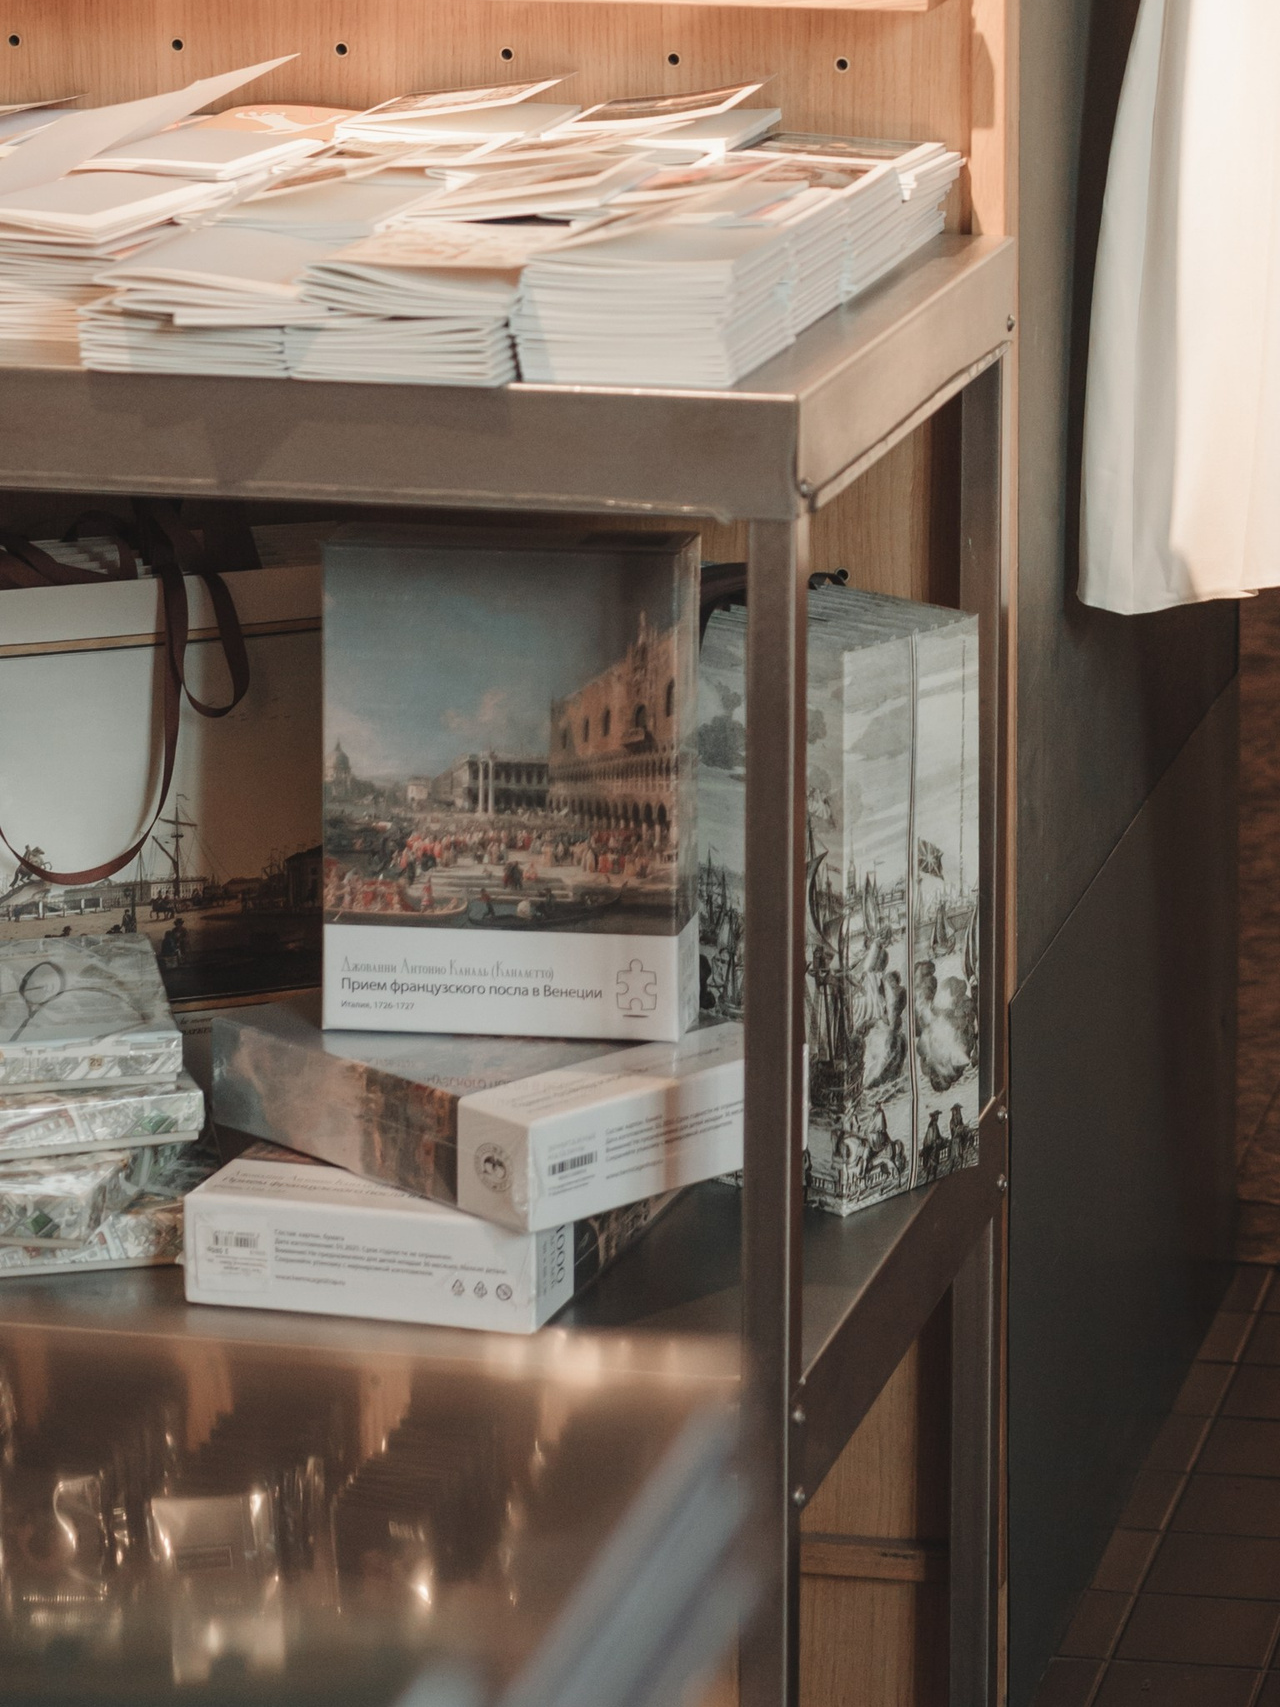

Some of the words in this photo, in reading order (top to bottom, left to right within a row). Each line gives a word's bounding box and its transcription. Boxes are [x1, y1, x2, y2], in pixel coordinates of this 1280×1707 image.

[341, 976, 387, 993] Прием
[390, 978, 486, 996] французского
[489, 984, 529, 996] посла
[532, 987, 540, 997] в
[543, 984, 603, 1000] Венеции
[374, 1000, 415, 1010] 1726-1727
[556, 1224, 566, 1285] 1000
